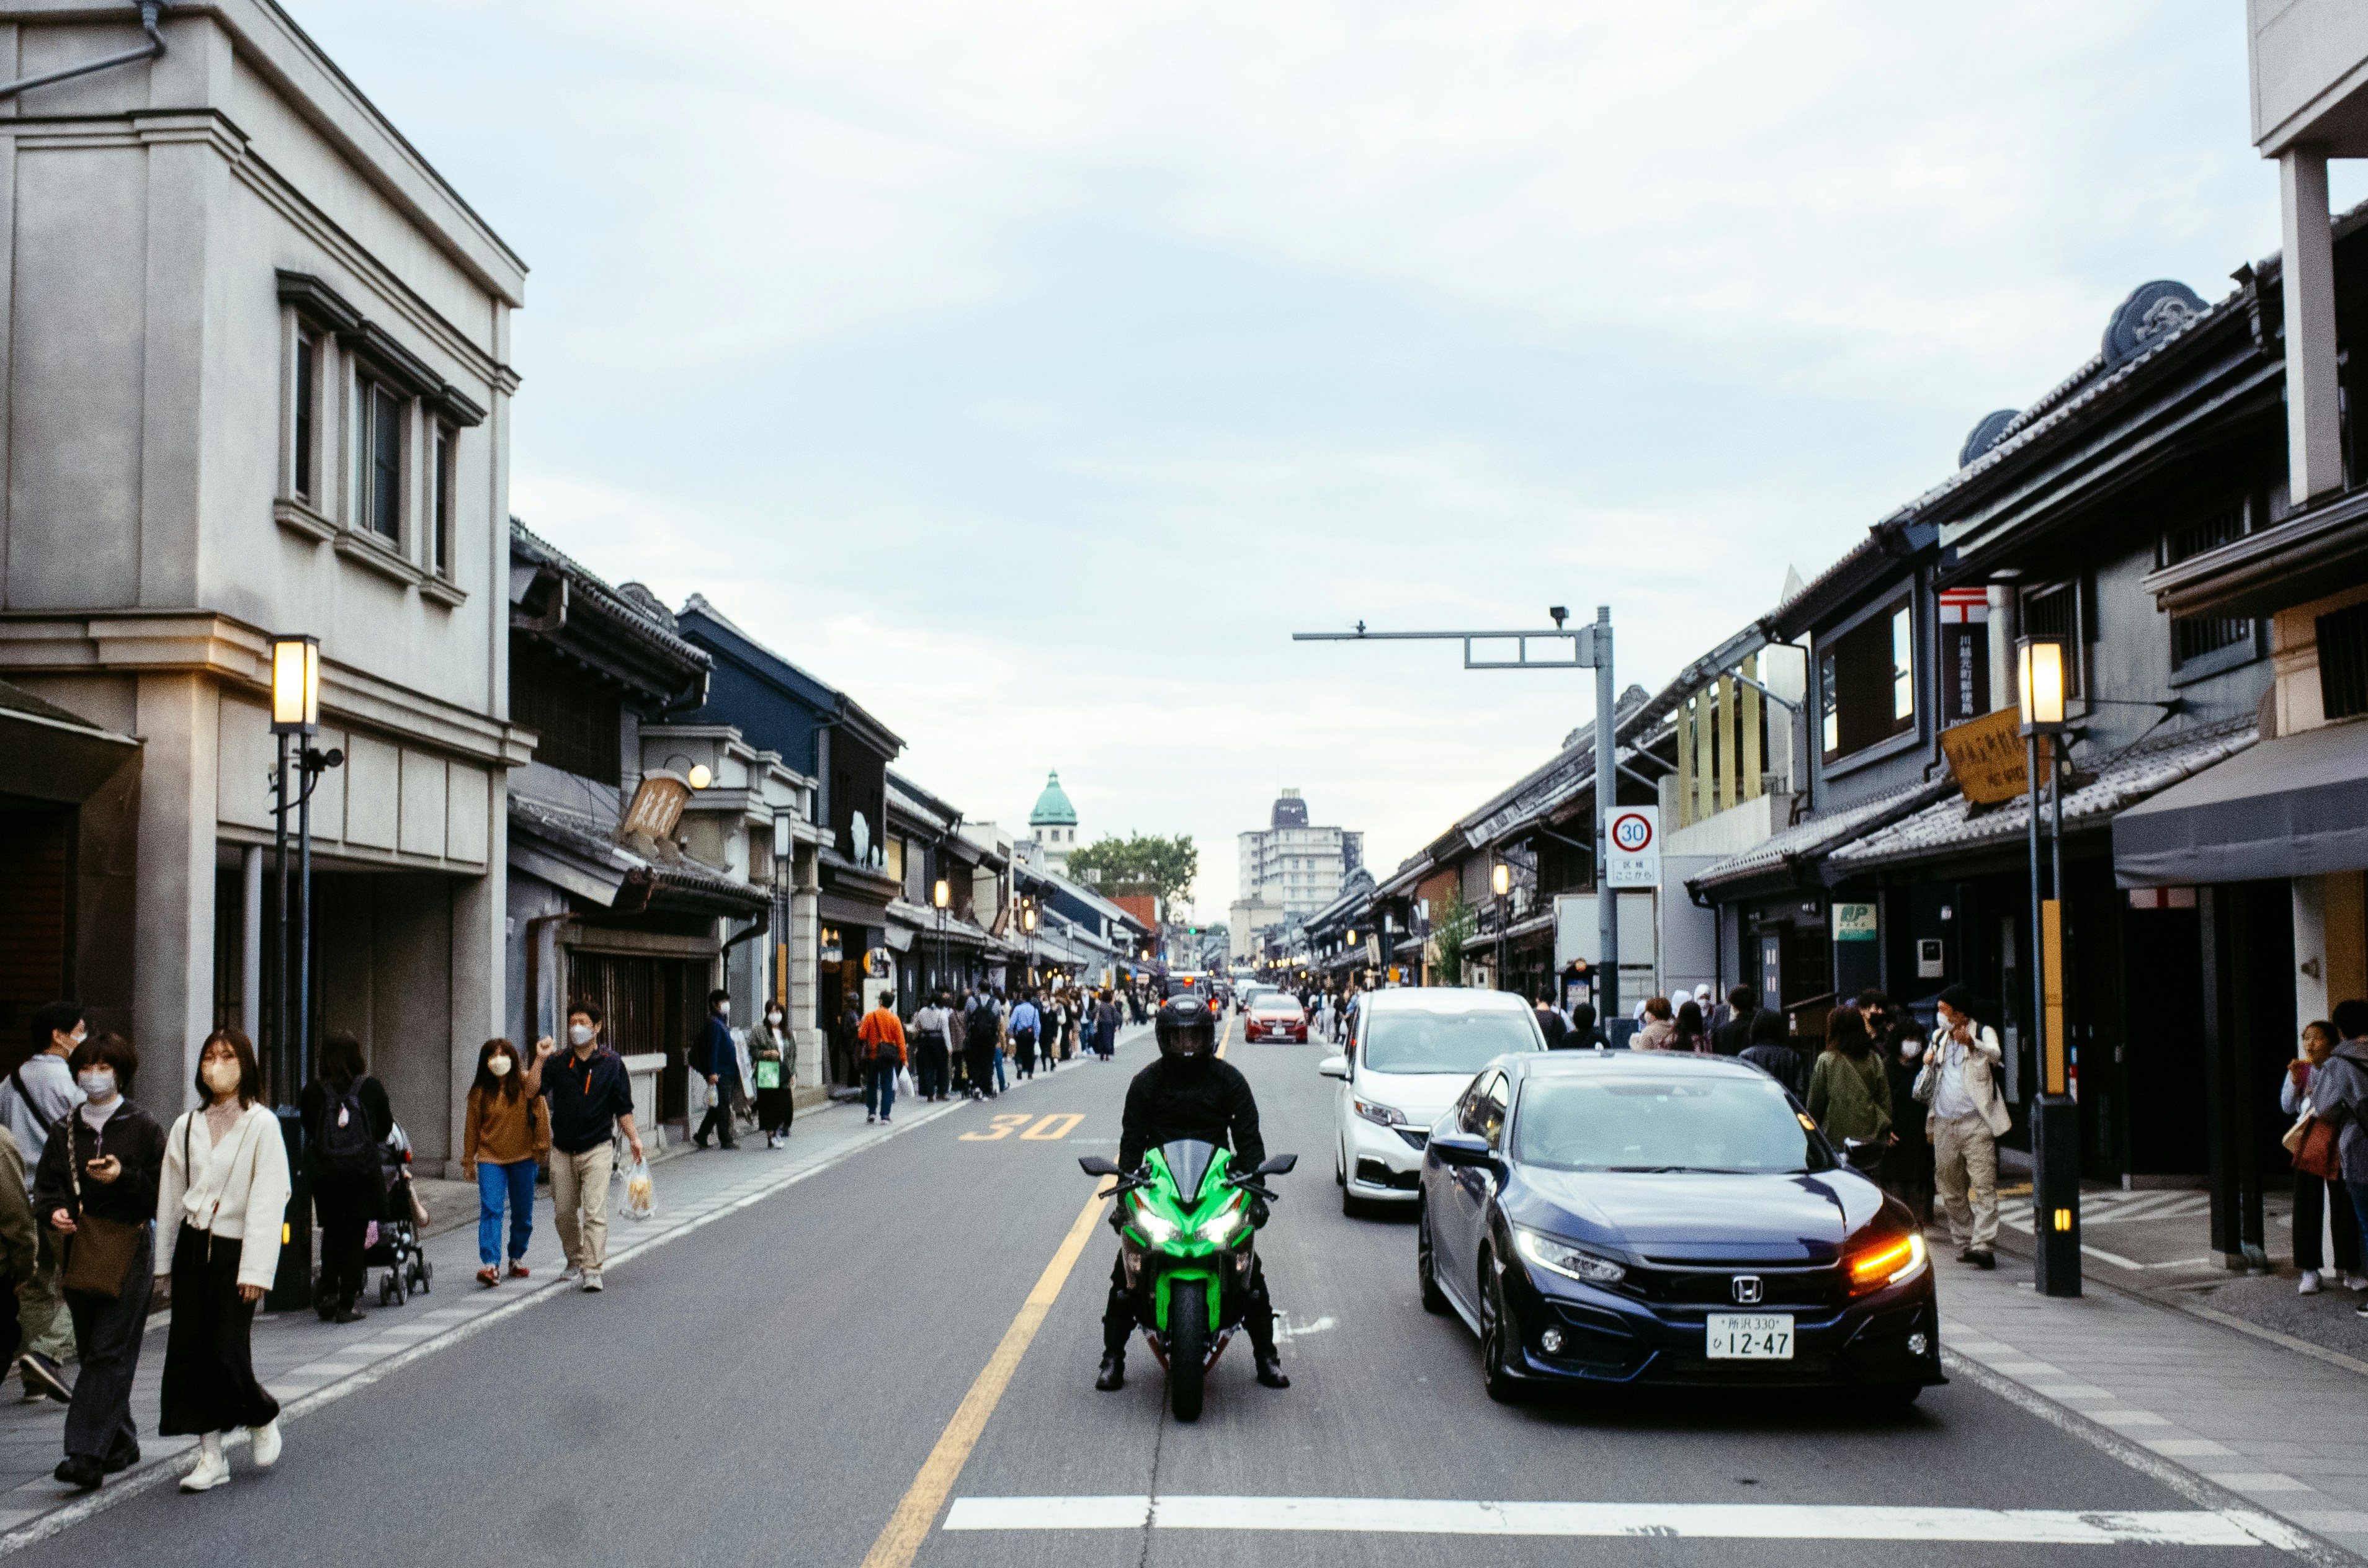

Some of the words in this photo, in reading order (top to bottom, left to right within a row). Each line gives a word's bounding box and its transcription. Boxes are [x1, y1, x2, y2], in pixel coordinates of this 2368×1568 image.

[1622, 824, 1643, 842] 30
[1616, 871, 1651, 880] ここから
[958, 1113, 1086, 1141] 30
[1754, 1318, 1775, 1330] 330
[1730, 1333, 1788, 1353] 12-47
